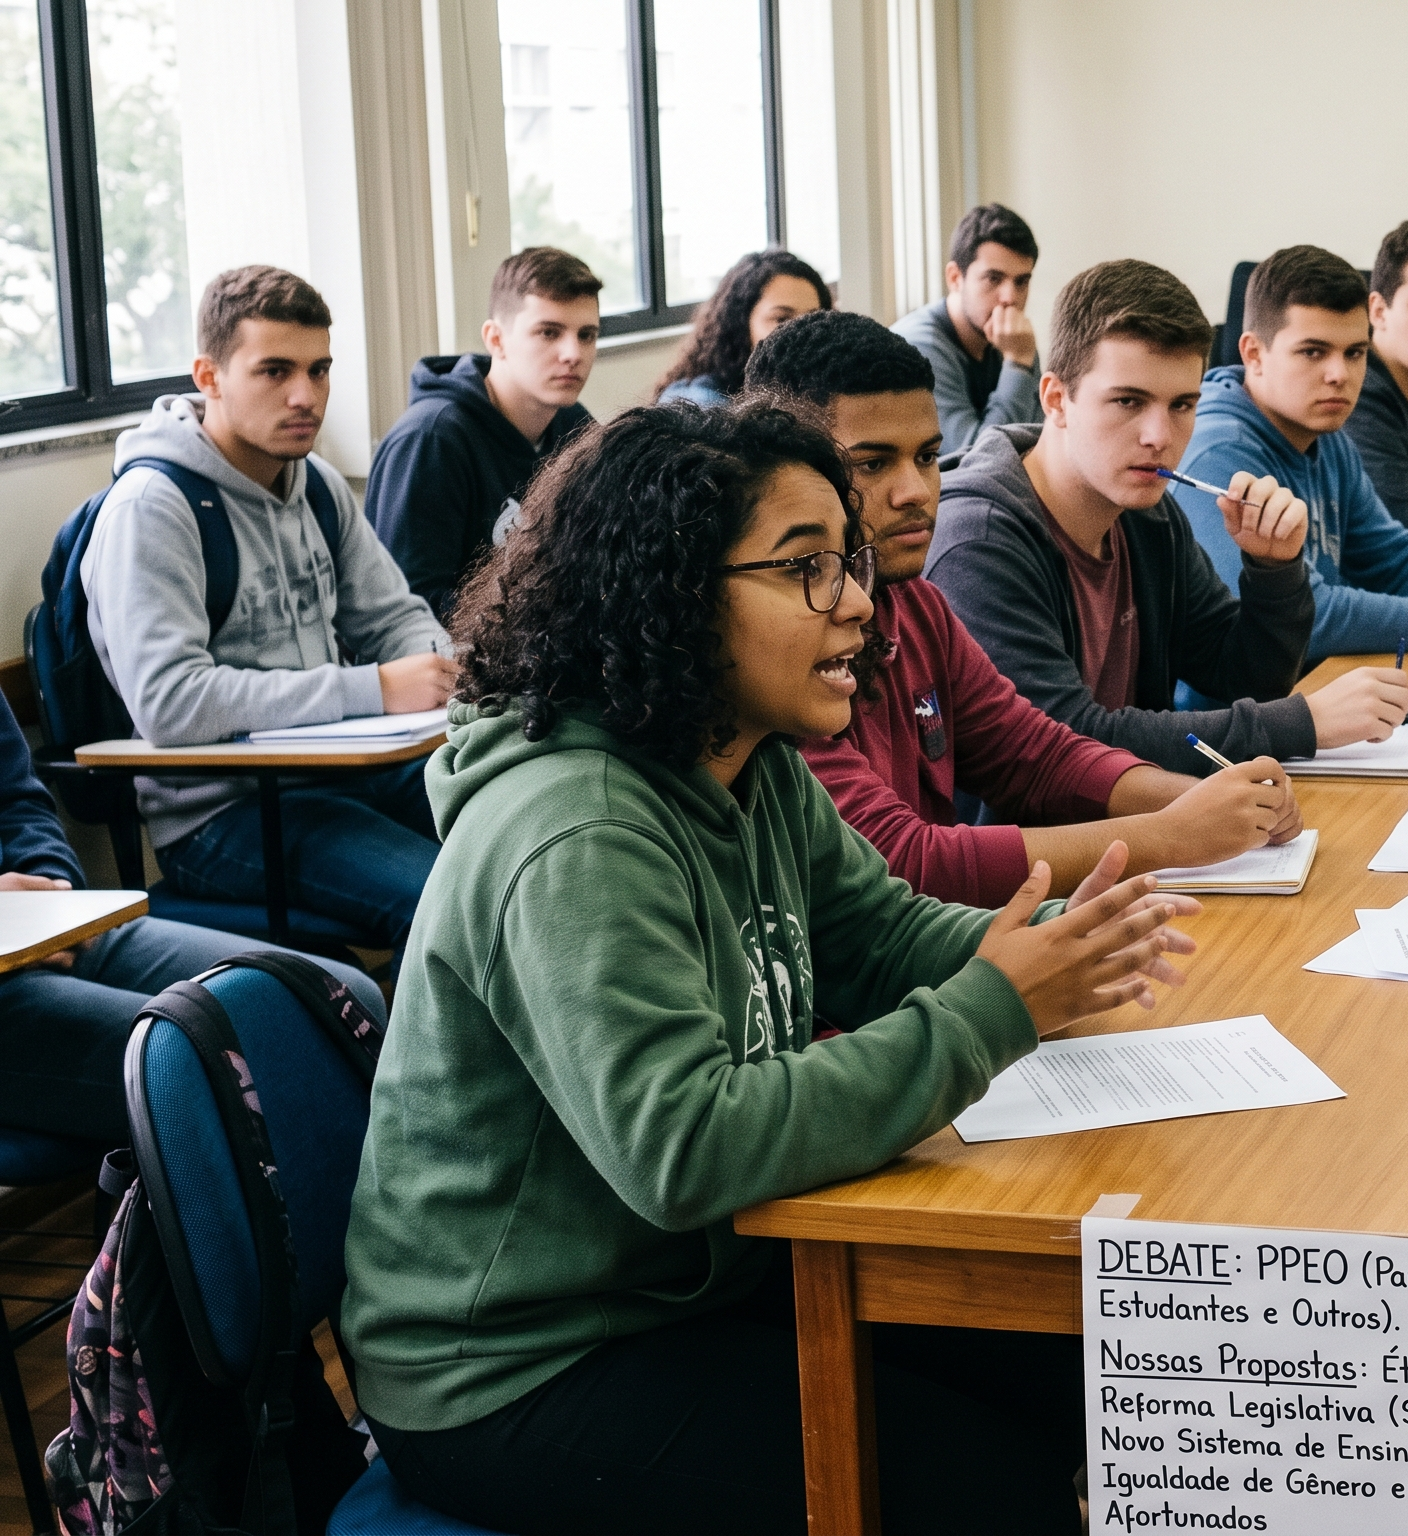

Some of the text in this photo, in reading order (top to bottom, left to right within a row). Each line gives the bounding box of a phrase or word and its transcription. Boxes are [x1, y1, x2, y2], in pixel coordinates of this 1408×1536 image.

[1099, 1239, 1241, 1277] DEBATE:
[1257, 1245, 1348, 1284] PPEO
[1100, 1289, 1399, 1333] Estudantes e Outros).
[1101, 1339, 1202, 1373] Nossas
[1218, 1343, 1366, 1387] Propostas:
[1101, 1386, 1215, 1422] Reforma
[1230, 1391, 1375, 1428] Legislativa
[1102, 1426, 1164, 1451] Novo
[1178, 1428, 1283, 1456] Sistema
[1296, 1433, 1324, 1458] de
[1102, 1463, 1229, 1497] Igualdade
[1244, 1468, 1273, 1492] de
[1286, 1468, 1375, 1497] Gênero
[1392, 1483, 1404, 1498] e
[1105, 1500, 1267, 1533] Afortunados
